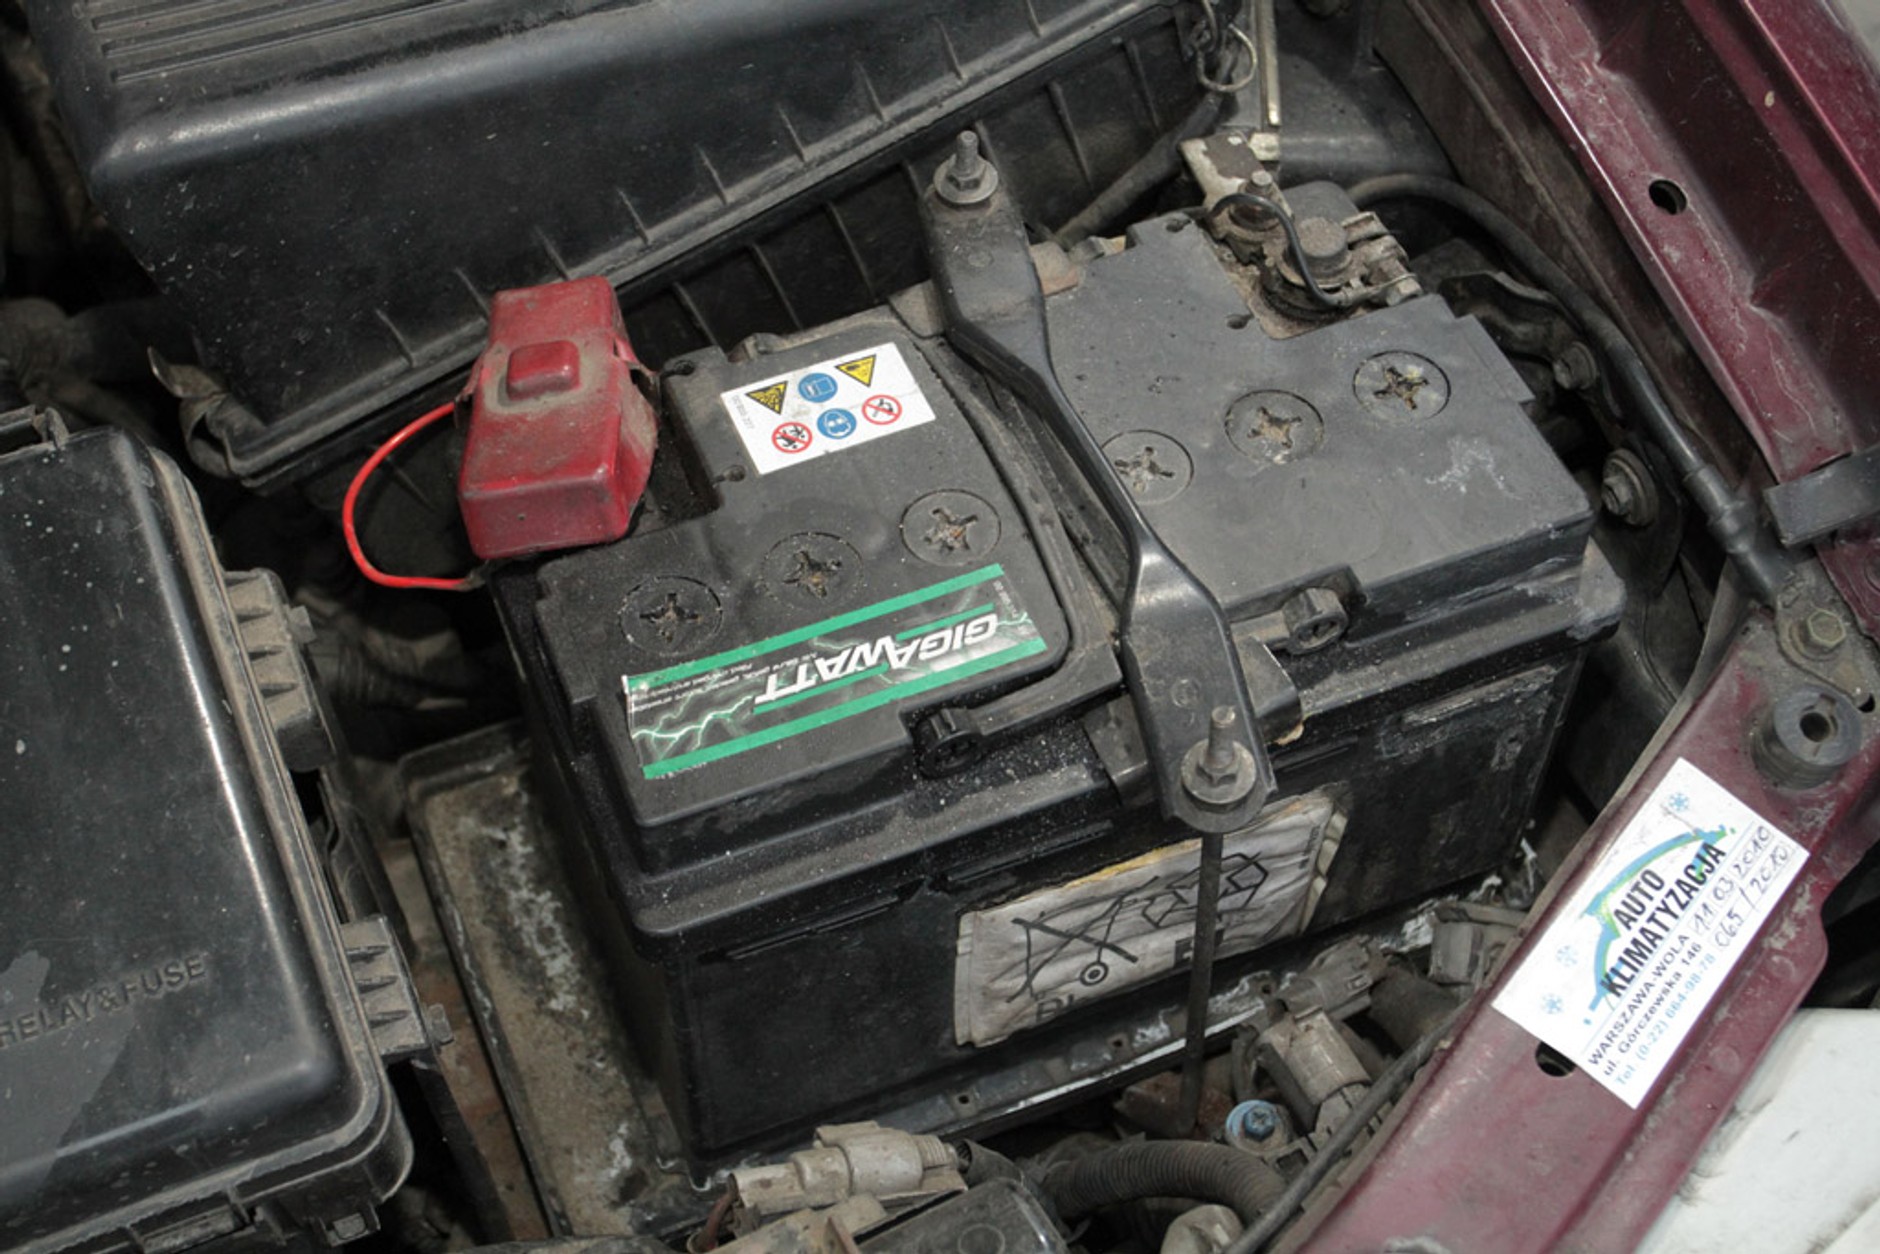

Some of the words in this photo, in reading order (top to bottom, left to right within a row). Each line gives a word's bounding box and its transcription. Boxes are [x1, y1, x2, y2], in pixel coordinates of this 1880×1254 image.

[754, 612, 998, 705] GIGAWATT
[1600, 842, 1726, 998] KLIMATYZACJA
[1613, 868, 1665, 932] AUTO
[1588, 934, 1690, 1067] WARSZAWA-WOLA
[1603, 1059, 1620, 1077] ul.
[1618, 971, 1682, 1054] Górczewska
[1682, 943, 1702, 967] 146
